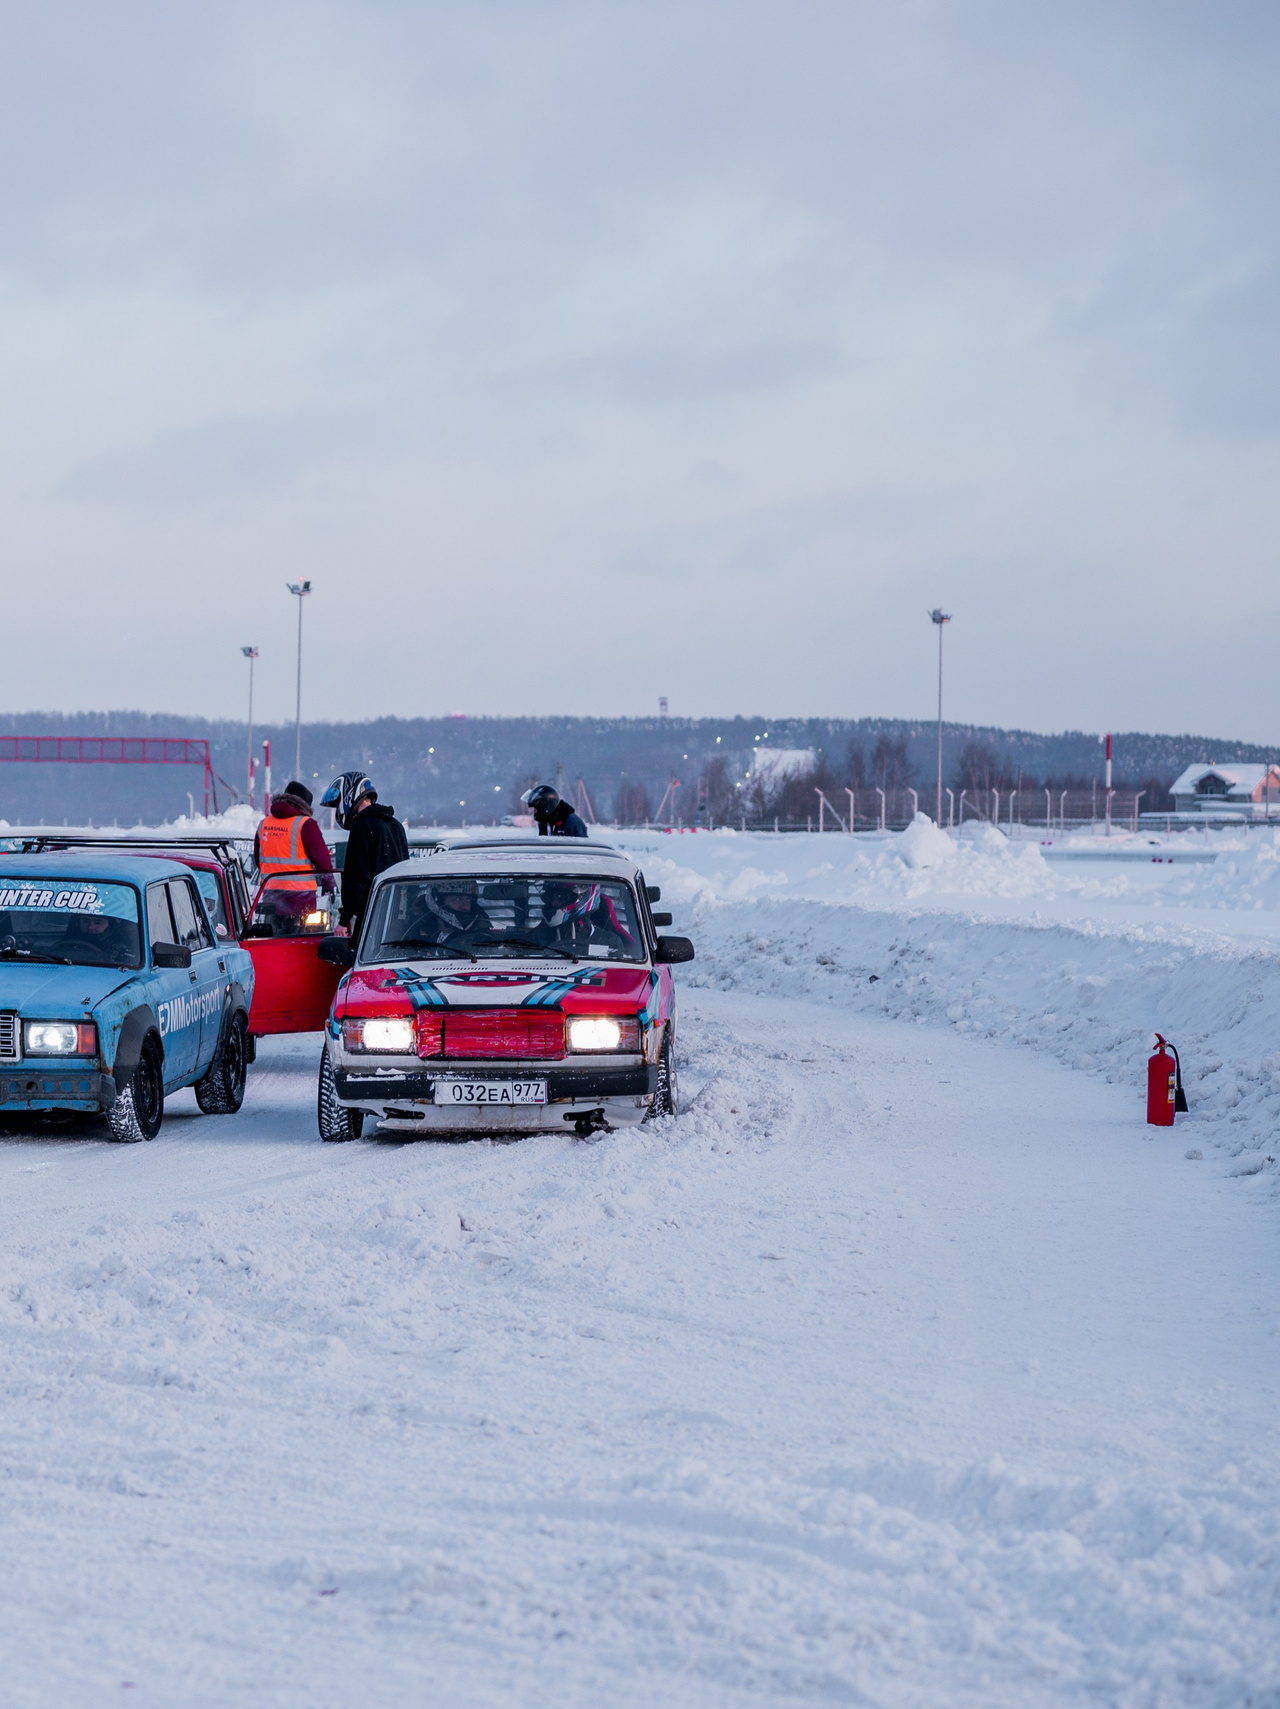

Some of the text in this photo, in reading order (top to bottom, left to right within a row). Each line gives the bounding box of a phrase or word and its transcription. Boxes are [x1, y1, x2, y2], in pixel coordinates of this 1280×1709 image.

[54, 890, 98, 909] CUP
[395, 974, 591, 985] MARTINI
[514, 1083, 540, 1096] 977
